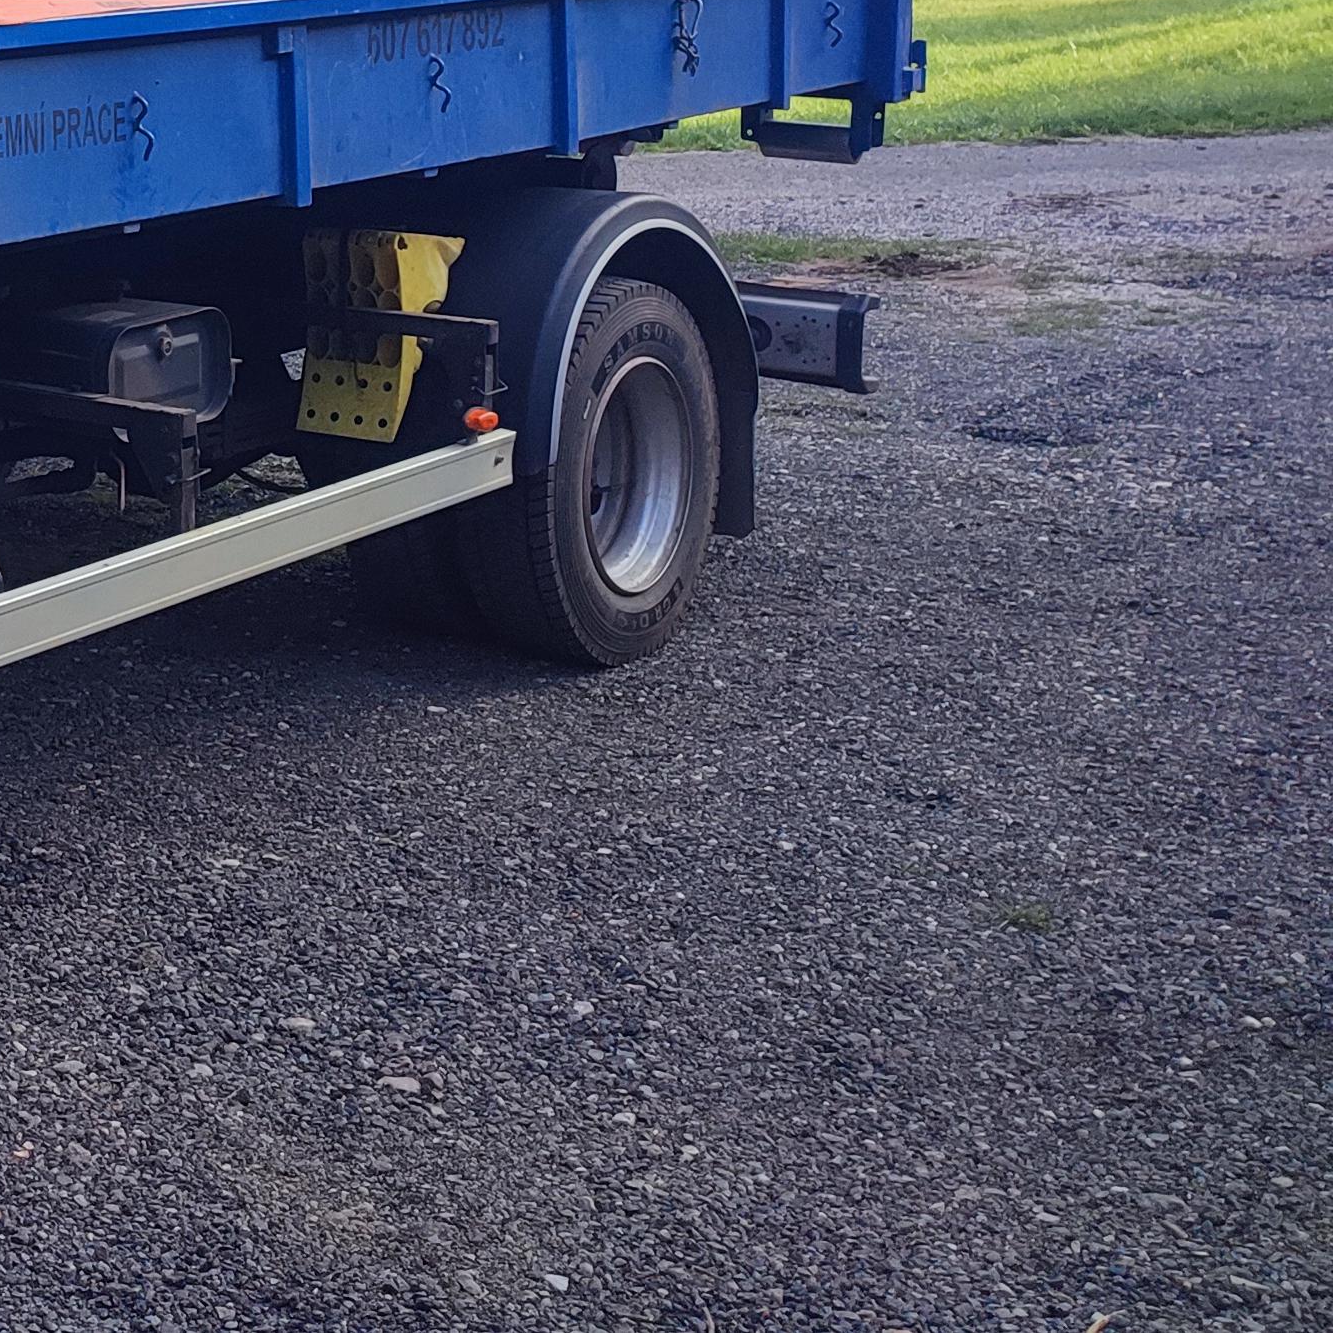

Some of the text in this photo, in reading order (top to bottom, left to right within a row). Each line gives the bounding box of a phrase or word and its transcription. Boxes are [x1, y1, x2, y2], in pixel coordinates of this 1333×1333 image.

[367, 17, 409, 64] 607
[463, 9, 504, 52] 892
[52, 95, 127, 152] PRÁCE
